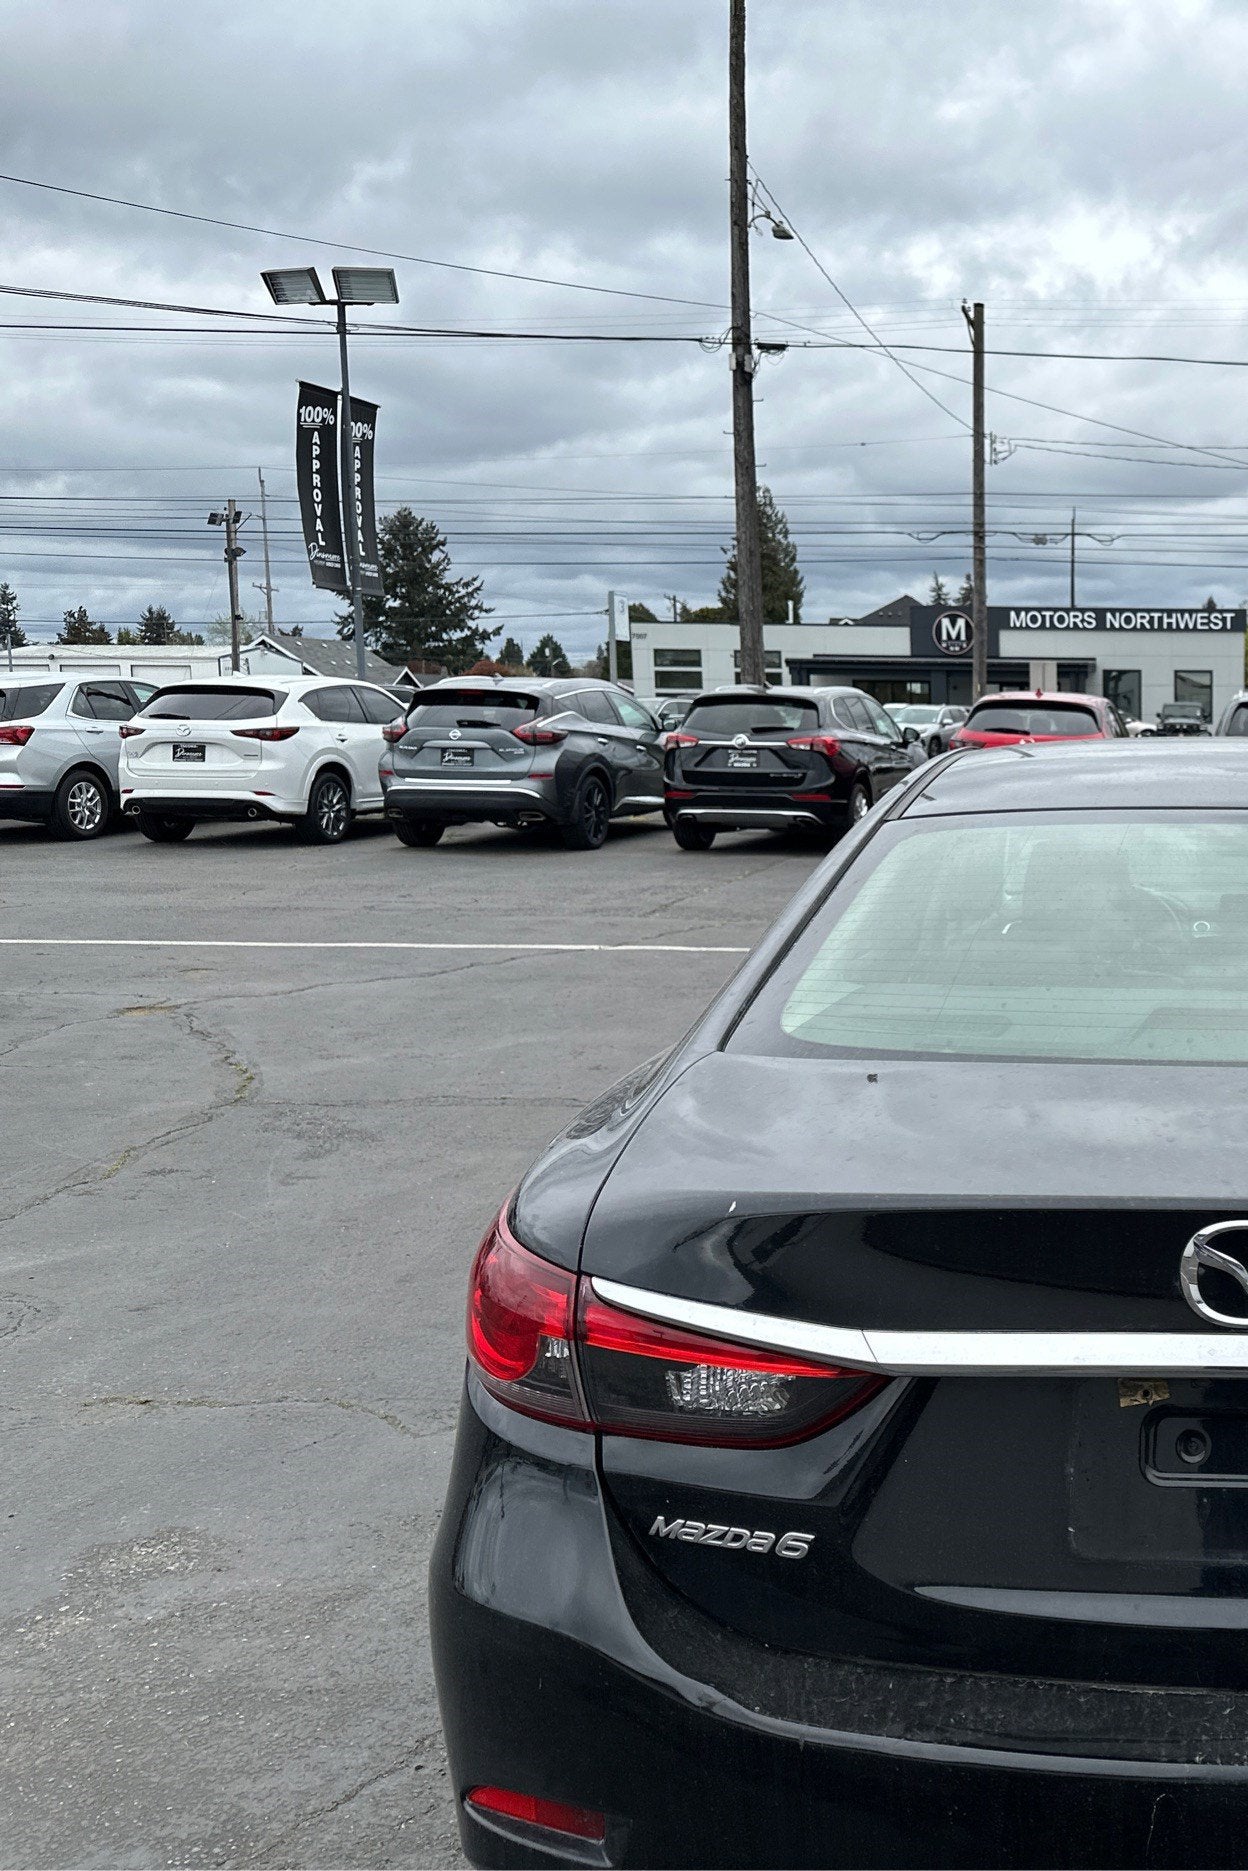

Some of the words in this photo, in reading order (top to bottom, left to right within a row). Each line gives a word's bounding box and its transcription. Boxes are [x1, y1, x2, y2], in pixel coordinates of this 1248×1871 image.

[299, 405, 335, 427] 100%
[311, 431, 326, 545] APPROVAL
[353, 445, 365, 555] APPROVAL
[940, 617, 967, 641] M
[1009, 610, 1097, 629] MOTORS
[1106, 612, 1236, 630] NORTHWEST
